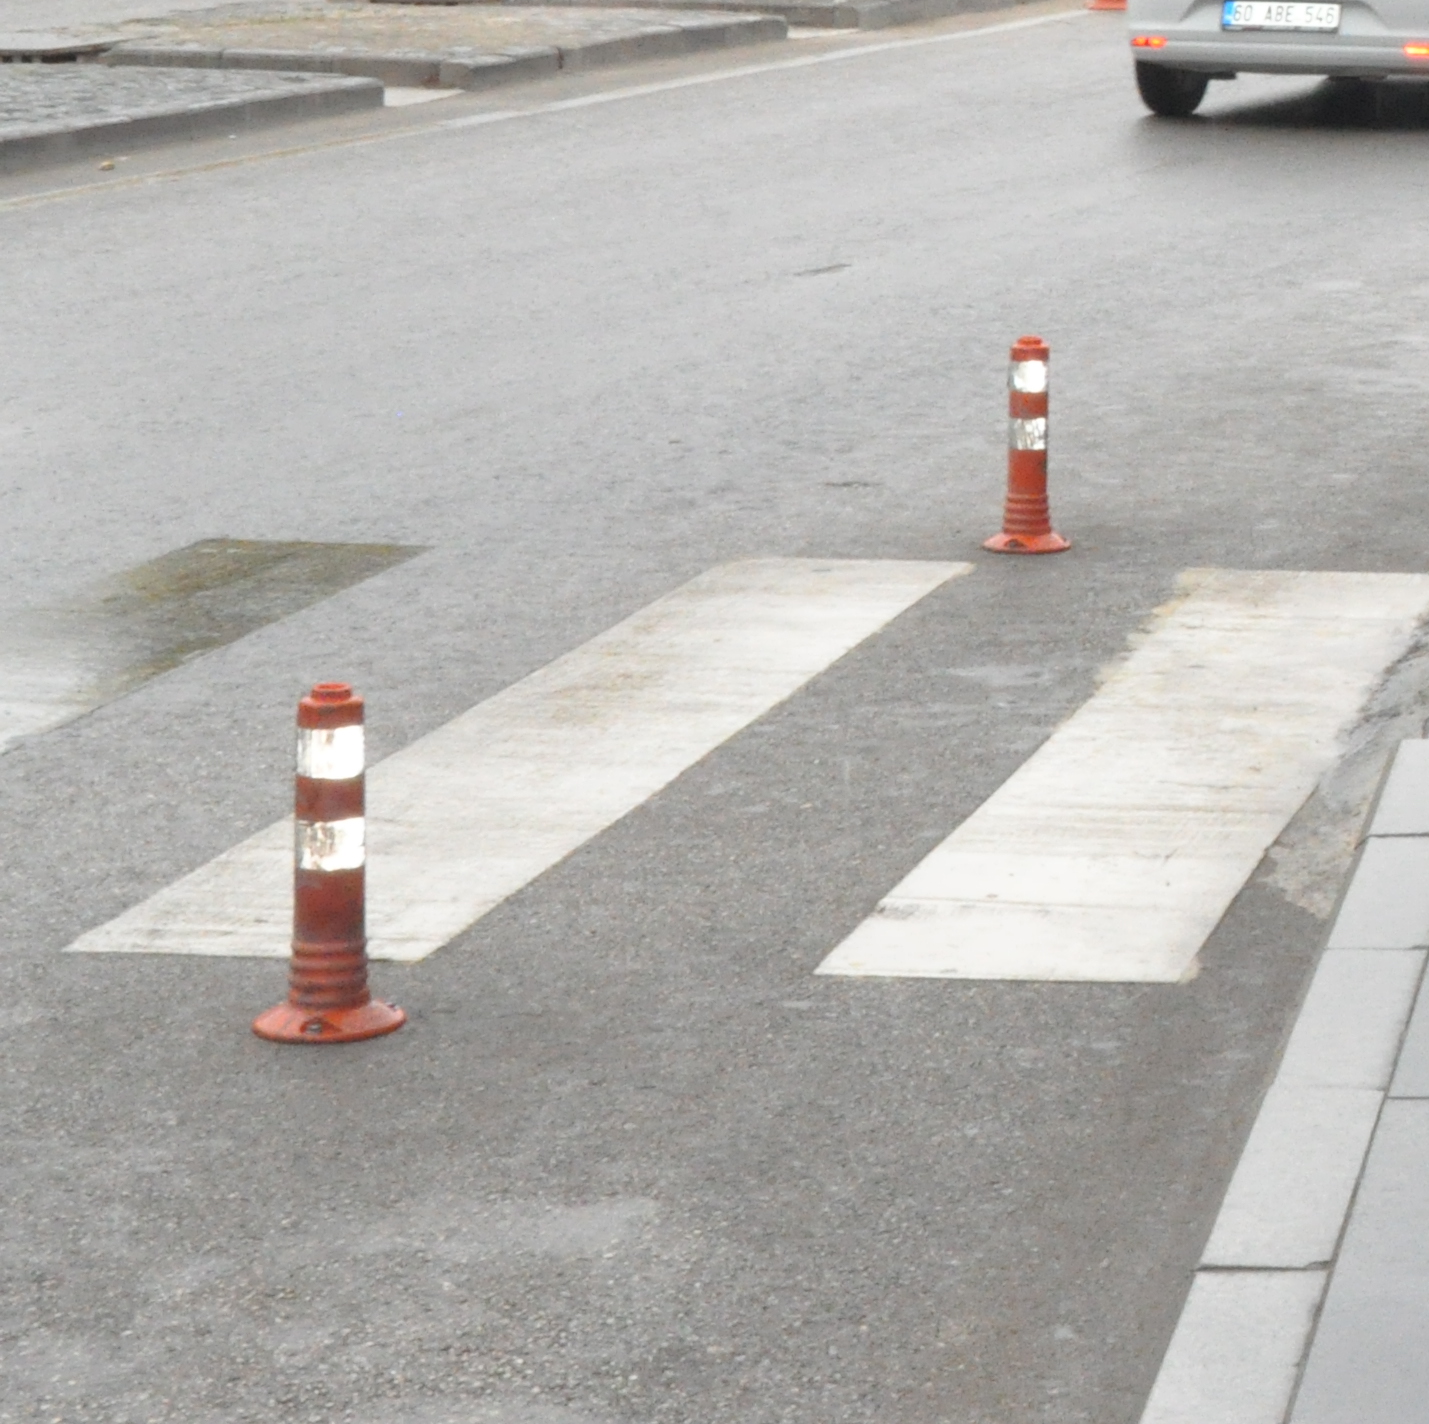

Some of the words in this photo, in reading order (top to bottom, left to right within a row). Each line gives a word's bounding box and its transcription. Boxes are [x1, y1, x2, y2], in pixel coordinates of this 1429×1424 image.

[1233, 4, 1253, 22] 60
[1265, 5, 1294, 23] ABE
[1305, 7, 1335, 24] 546
